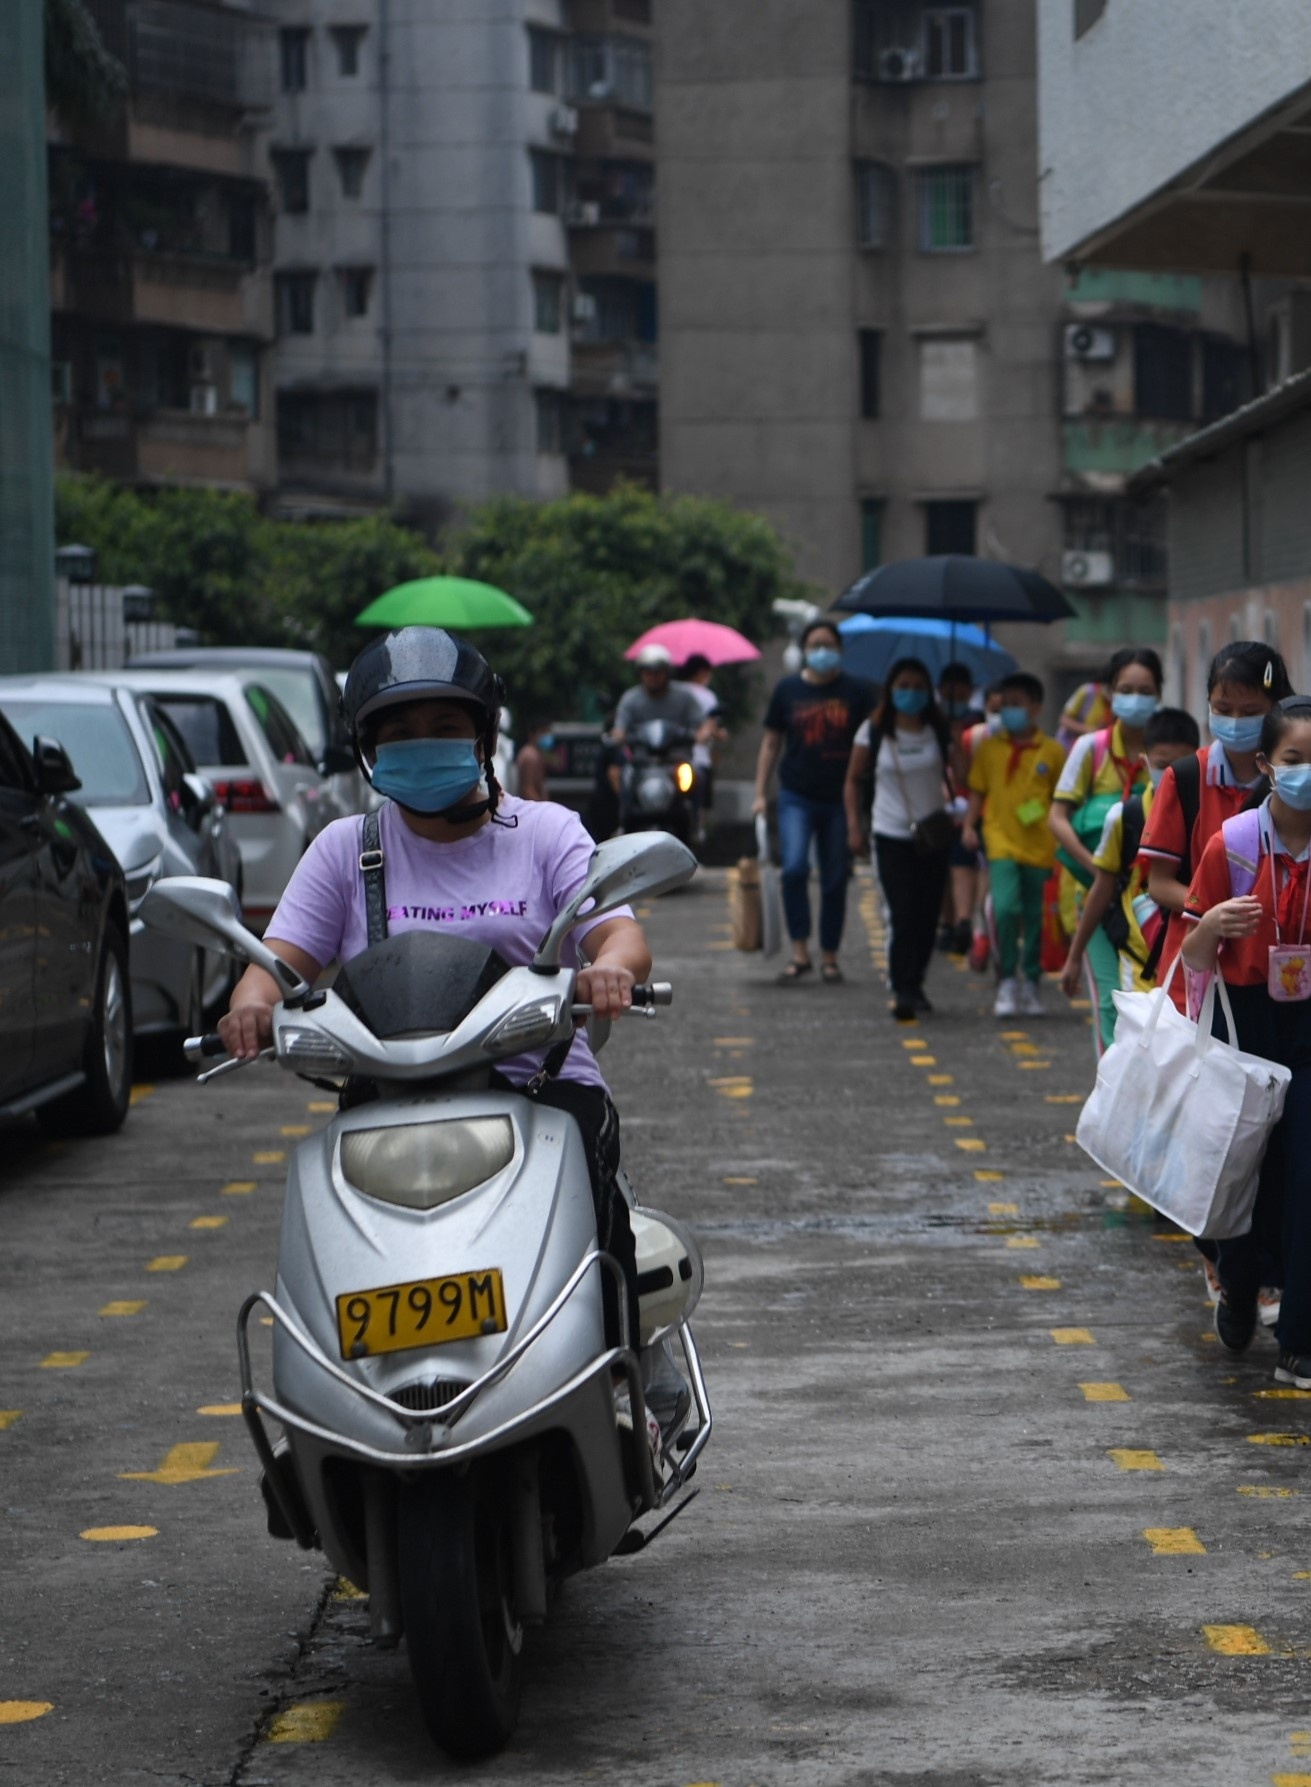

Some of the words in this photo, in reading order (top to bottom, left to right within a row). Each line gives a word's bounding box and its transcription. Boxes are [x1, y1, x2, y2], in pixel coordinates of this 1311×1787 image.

[386, 905, 454, 922] EATING
[460, 901, 527, 921] MYSELF
[346, 1273, 496, 1342] 9799M
